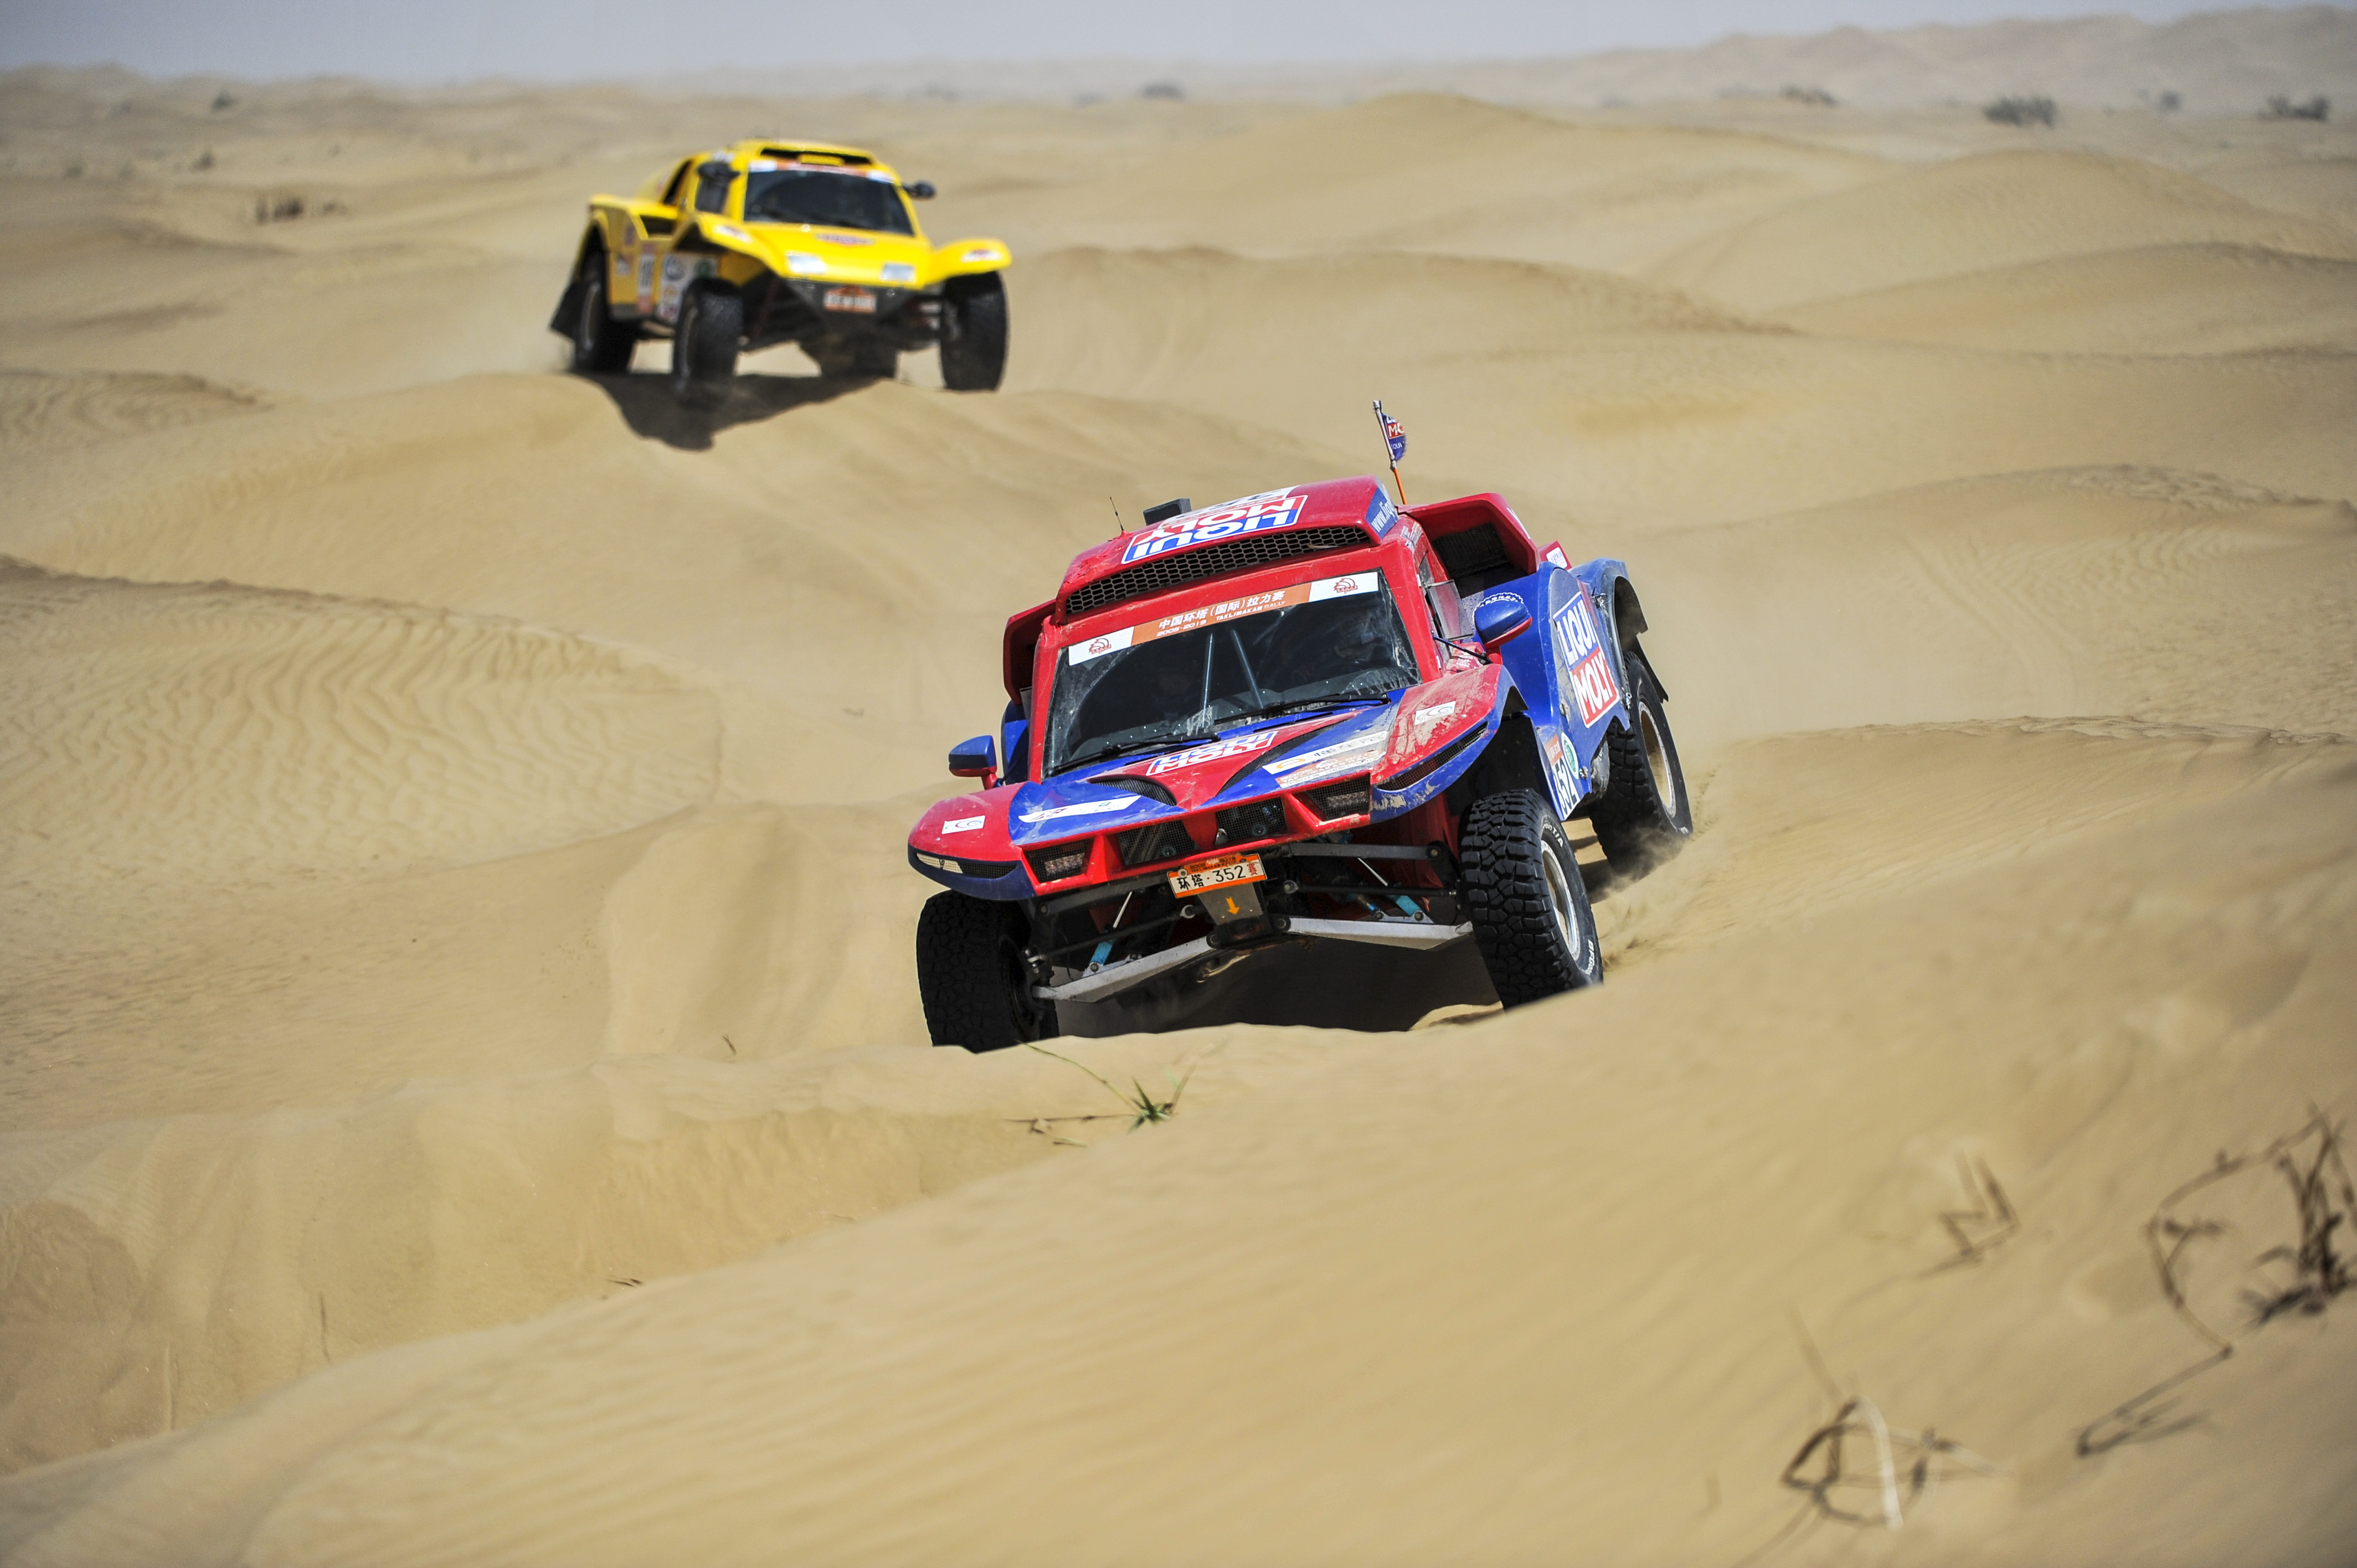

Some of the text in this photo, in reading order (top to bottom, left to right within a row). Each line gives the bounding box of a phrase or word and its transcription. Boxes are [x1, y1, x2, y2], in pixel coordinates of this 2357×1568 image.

[1133, 510, 1290, 559] LIQUI
[1134, 498, 1297, 546] MOLY
[1156, 620, 1207, 637] 2005-2019
[1216, 605, 1263, 621] TAKLIMAKAN
[1557, 599, 1596, 666] LIQUI
[1573, 651, 1613, 720] MOLY
[1155, 738, 1269, 772] MOLY
